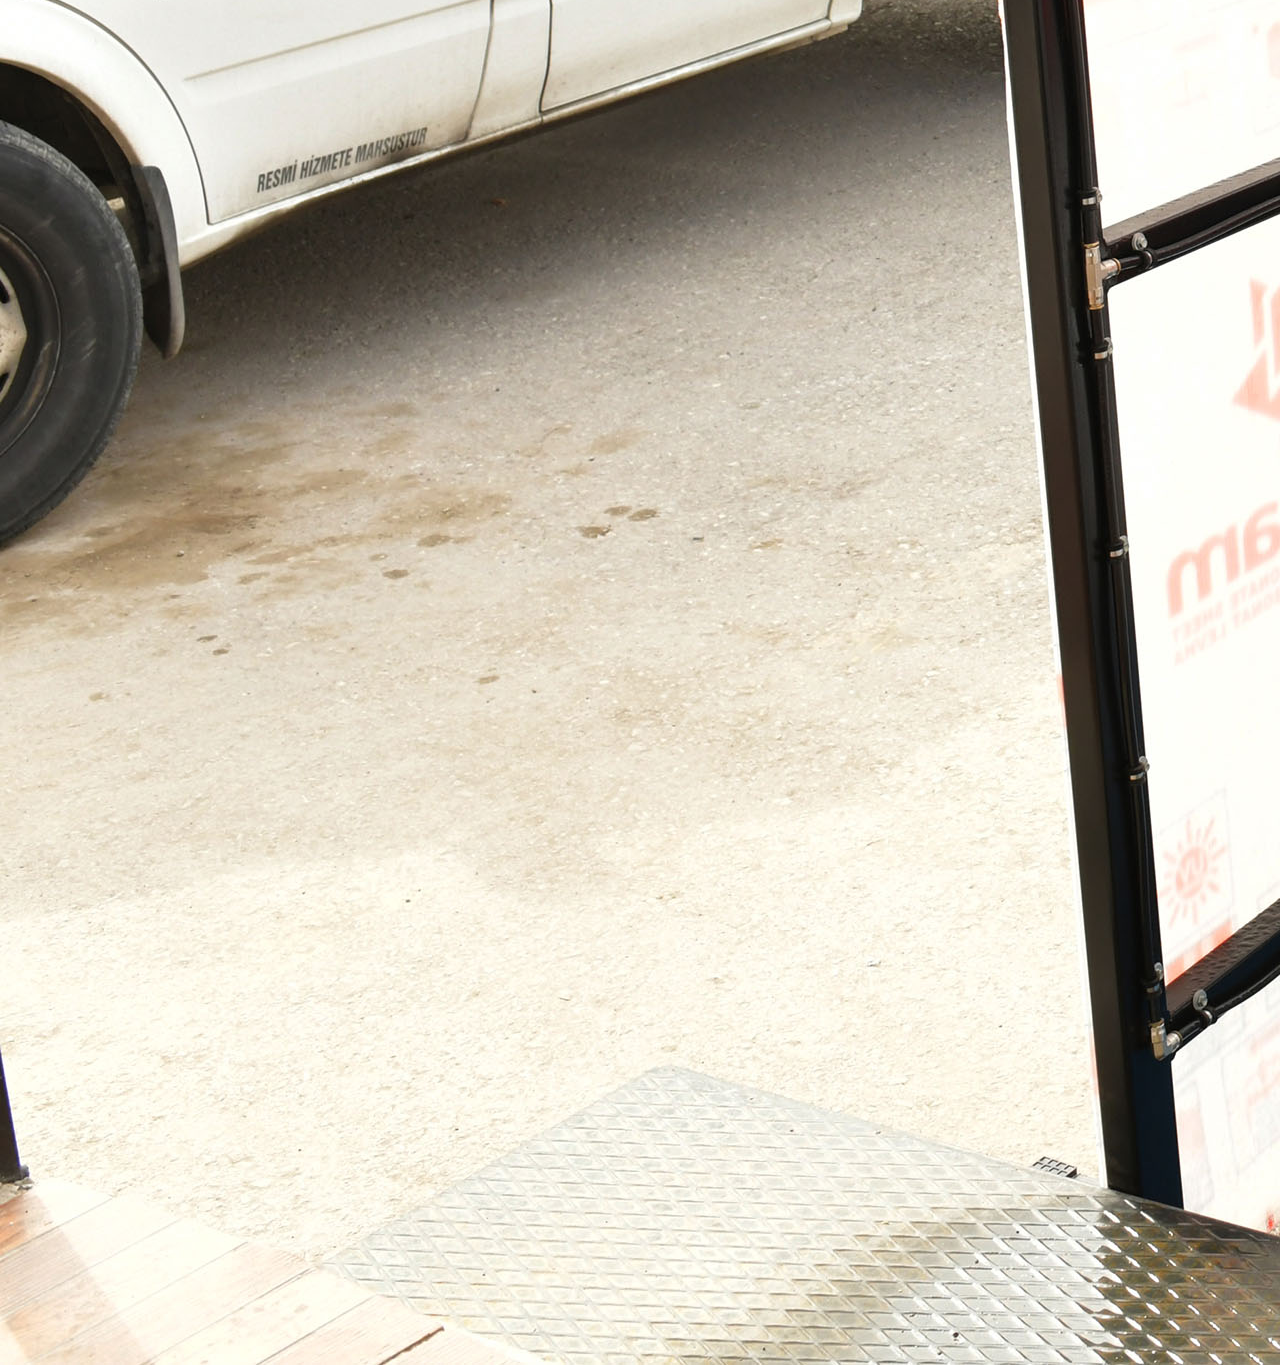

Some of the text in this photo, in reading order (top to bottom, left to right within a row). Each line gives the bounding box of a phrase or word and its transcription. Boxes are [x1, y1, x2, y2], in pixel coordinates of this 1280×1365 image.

[257, 127, 428, 193] RESMİ HİZMETE MAHSUSTUR
